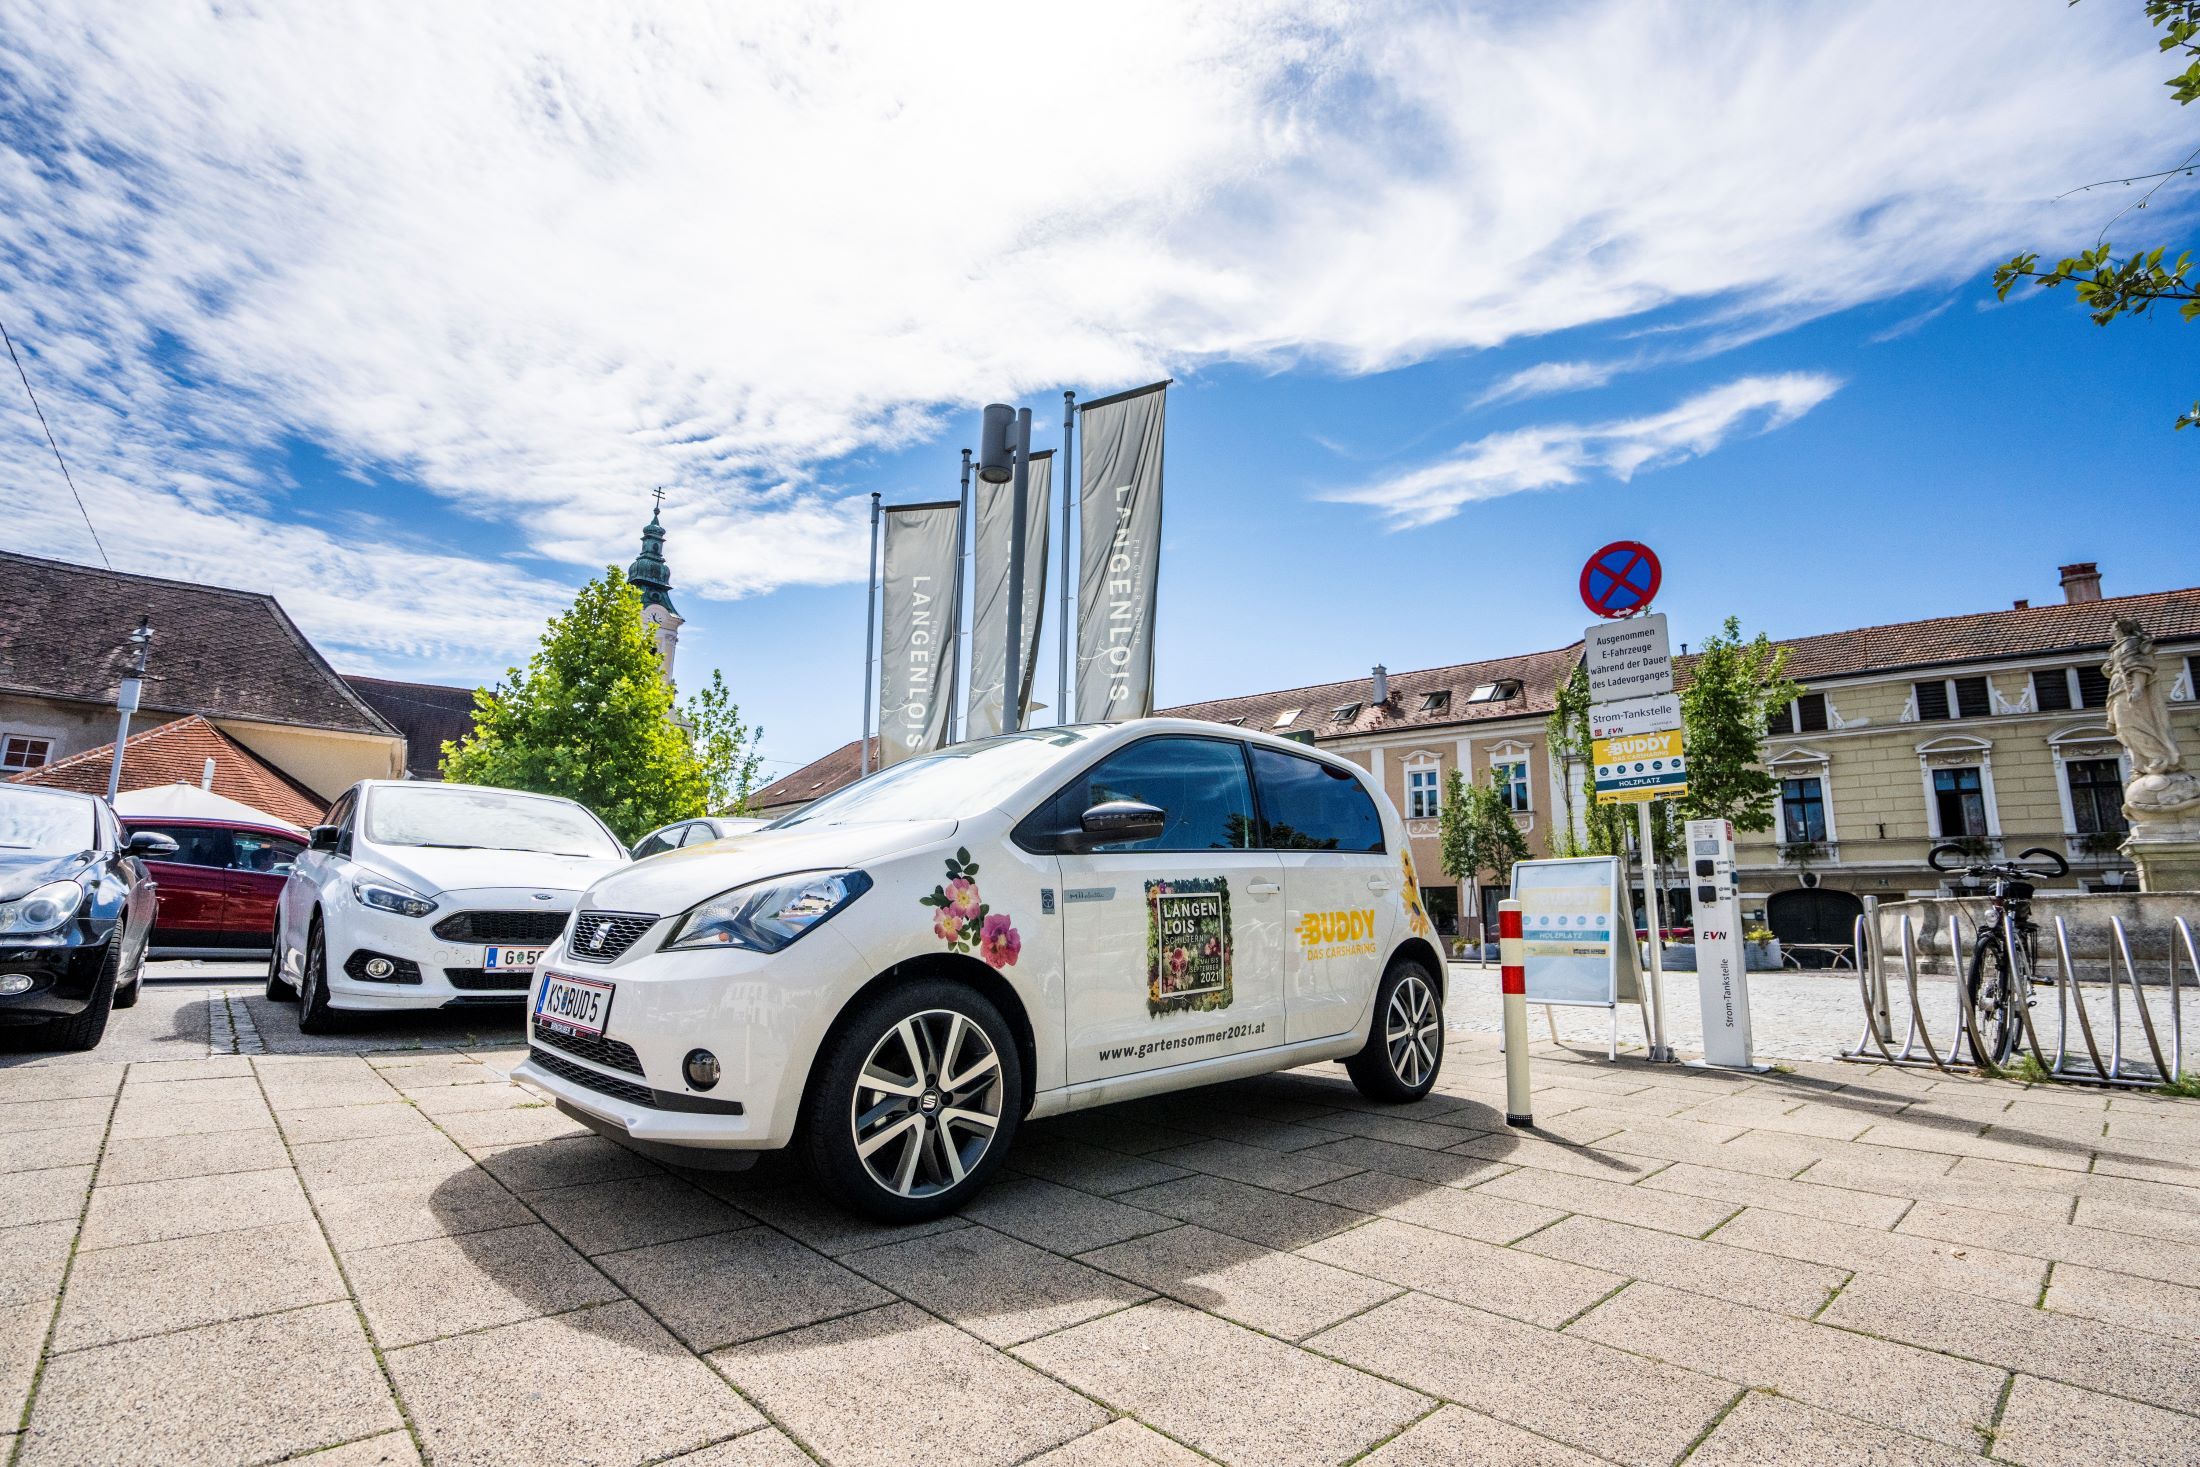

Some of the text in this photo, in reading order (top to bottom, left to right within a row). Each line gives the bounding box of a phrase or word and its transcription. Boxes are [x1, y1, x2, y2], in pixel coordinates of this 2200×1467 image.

[1109, 485, 1131, 700] LANGENLOIS
[1597, 629, 1655, 646] Ausgenommen
[1602, 644, 1652, 659] E-Fahrzeuge
[906, 575, 931, 748] LANGENLOIS
[1591, 655, 1667, 675] während der Dauer
[1592, 670, 1669, 689] des Ladevorganges
[1593, 705, 1672, 724] Strom-Tankstelle
[1608, 727, 1623, 735] EVN
[1607, 735, 1671, 756] BUDDY
[1619, 777, 1661, 787] HOLZPLATZ
[1163, 902, 1217, 918] LANGEN
[1164, 919, 1195, 935] LOIS
[1300, 909, 1375, 946] BUDDY
[1540, 931, 1583, 939] HOLZPLATZ
[1703, 931, 1727, 940] EVN
[1165, 934, 1204, 945] SCHILTERN
[505, 950, 515, 965] G
[1307, 942, 1376, 961] DAS CARSHARING
[1200, 971, 1220, 983] 2021
[547, 983, 563, 1013] KS
[1721, 958, 1734, 1028] Strom-Tankstelle
[1099, 1022, 1266, 1062] www.gartensommer2021.at
